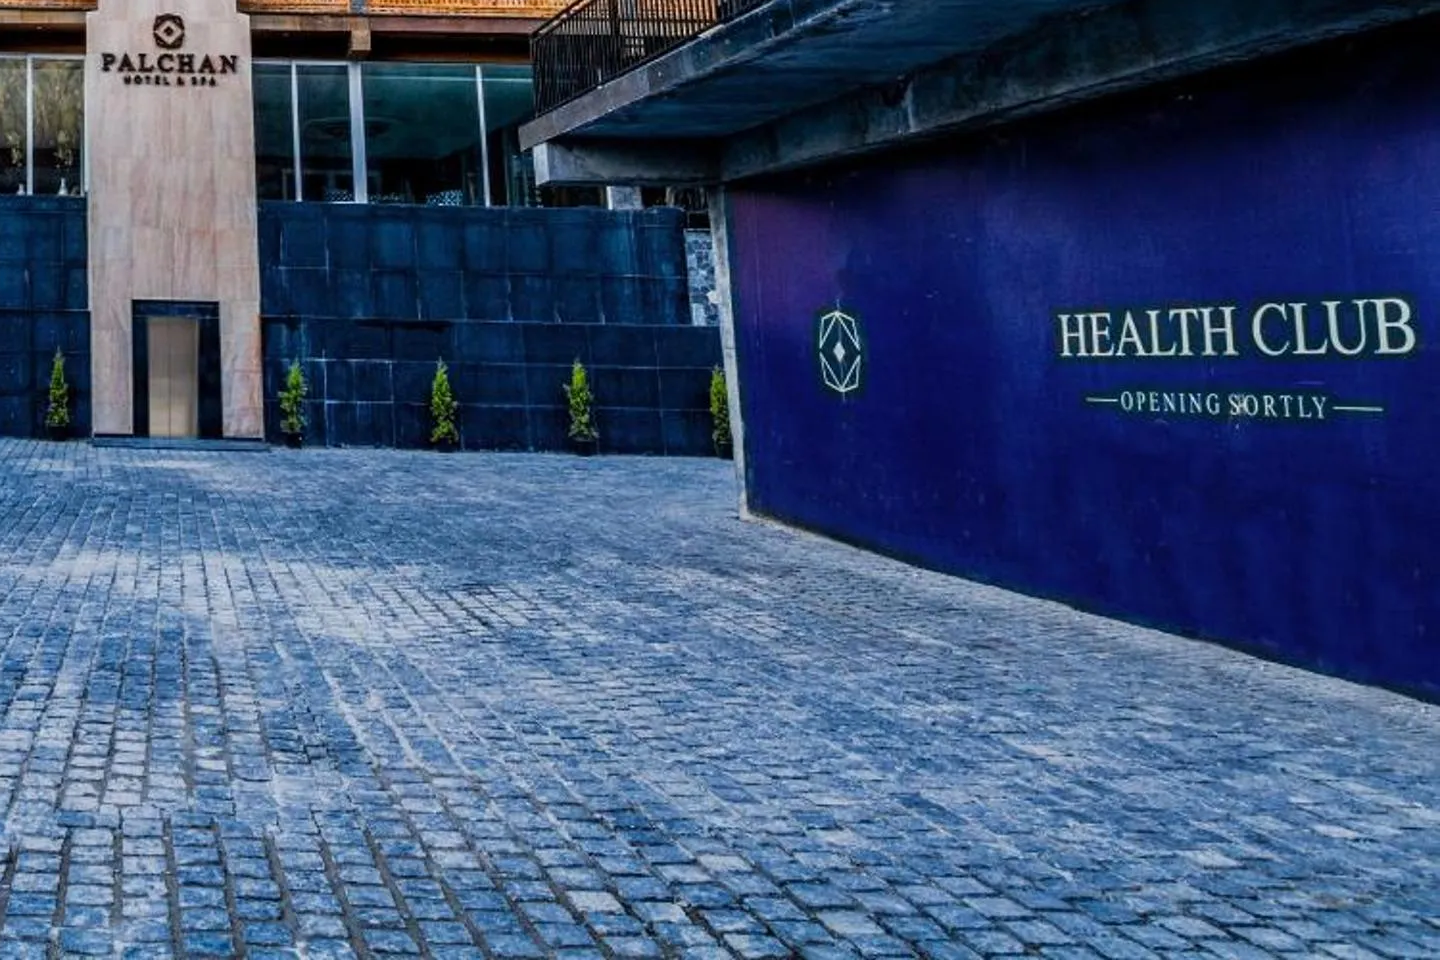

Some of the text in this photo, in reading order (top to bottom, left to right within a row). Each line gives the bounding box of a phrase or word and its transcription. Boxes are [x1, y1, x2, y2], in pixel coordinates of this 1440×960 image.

[101, 52, 239, 74] PALCHAN
[124, 75, 170, 86] HOTEL
[191, 76, 217, 87] SPA
[1058, 297, 1416, 357] HEALTH CLUB
[1120, 391, 1220, 415] OPENING
